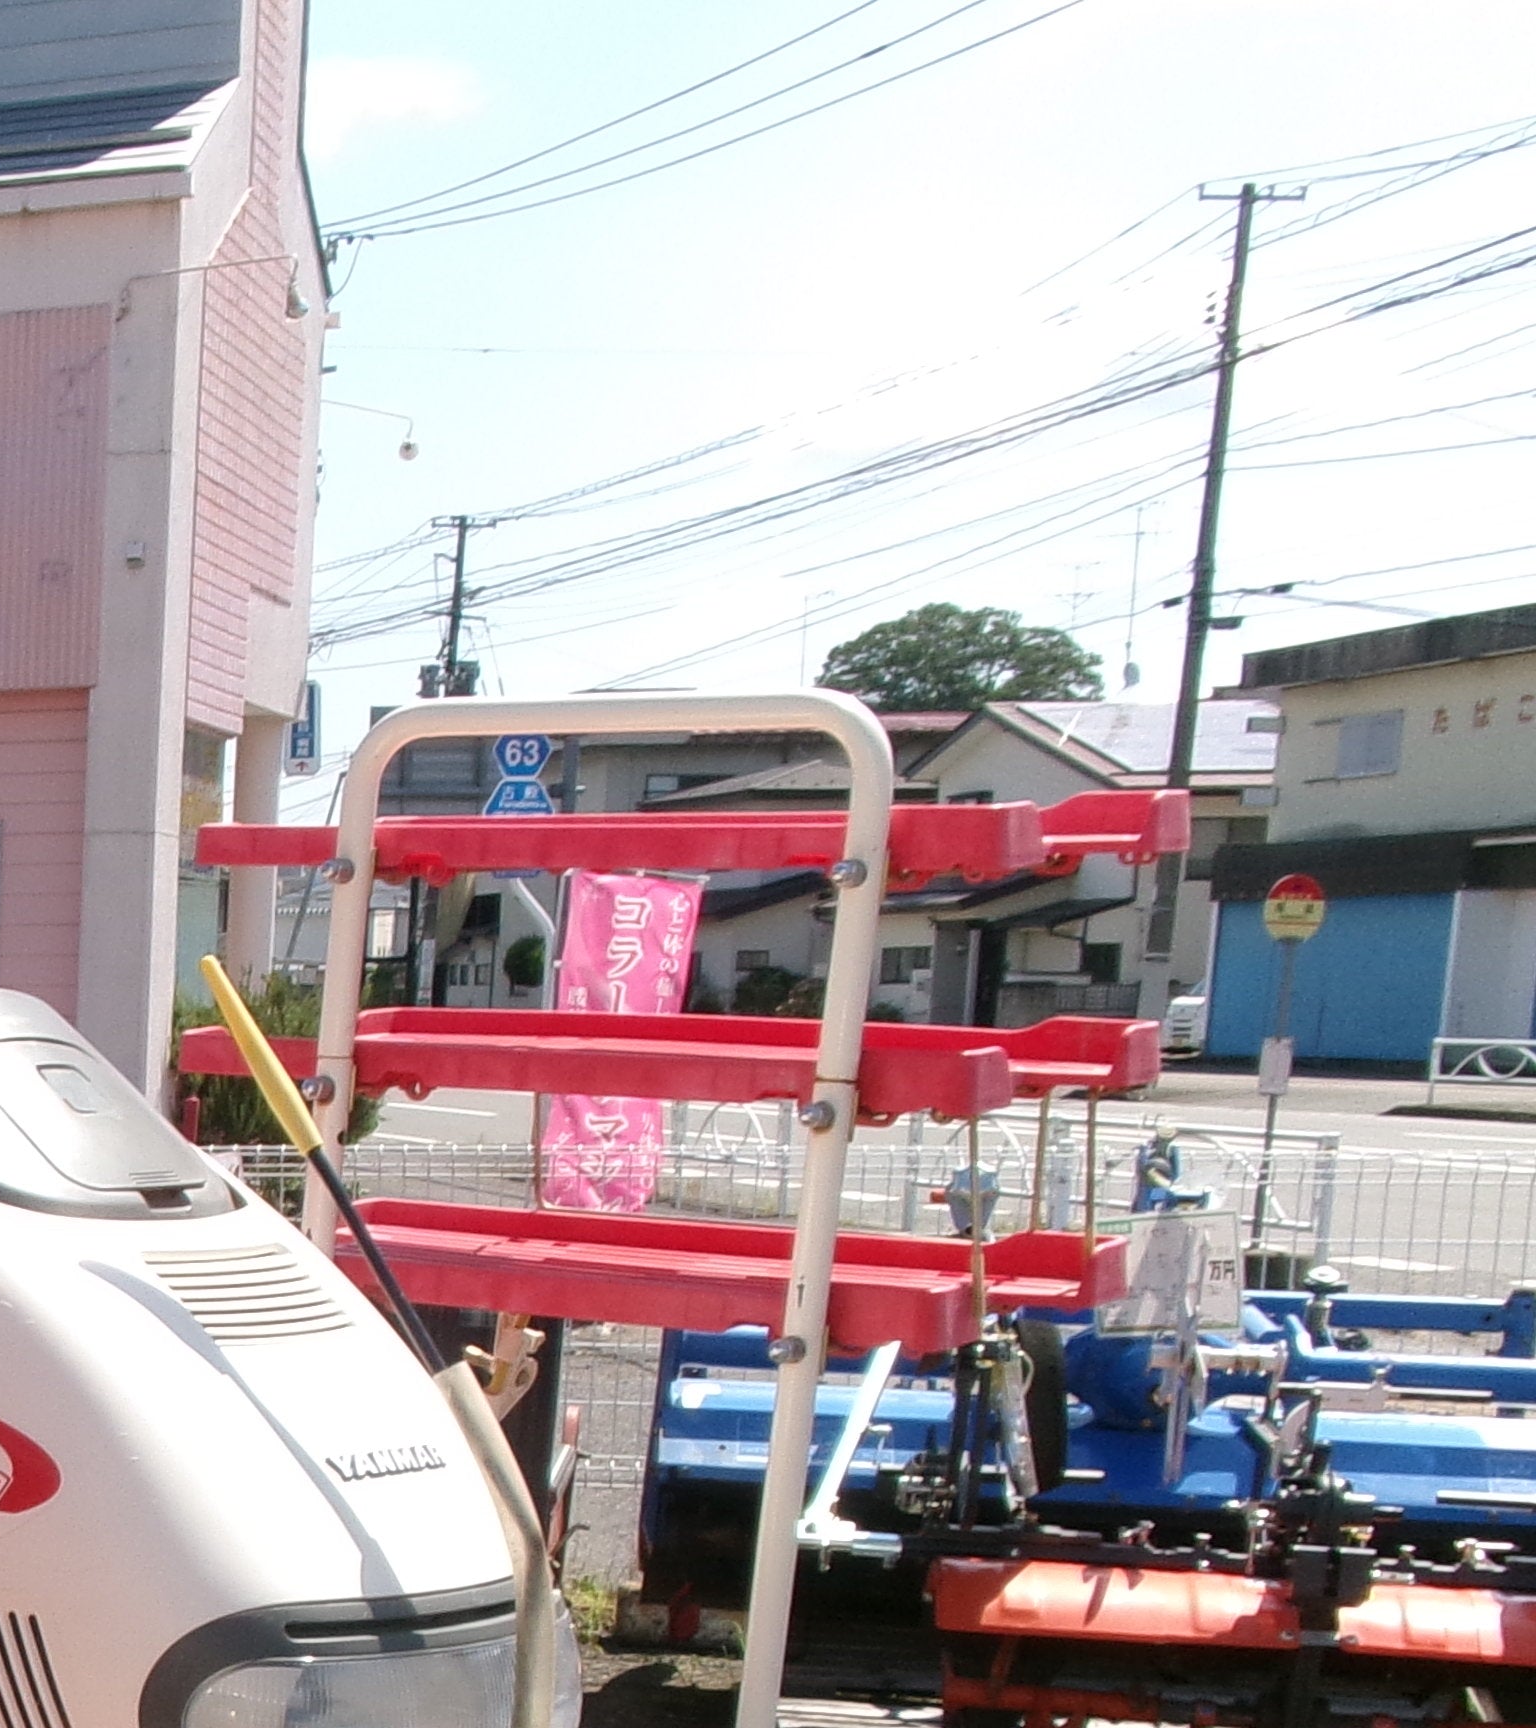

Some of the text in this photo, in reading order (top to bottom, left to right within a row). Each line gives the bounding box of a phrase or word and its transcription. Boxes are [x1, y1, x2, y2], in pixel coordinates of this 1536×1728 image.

[505, 739, 540, 767] 63
[1208, 1259, 1236, 1281] 万円
[325, 1444, 447, 1482] YANMAR
